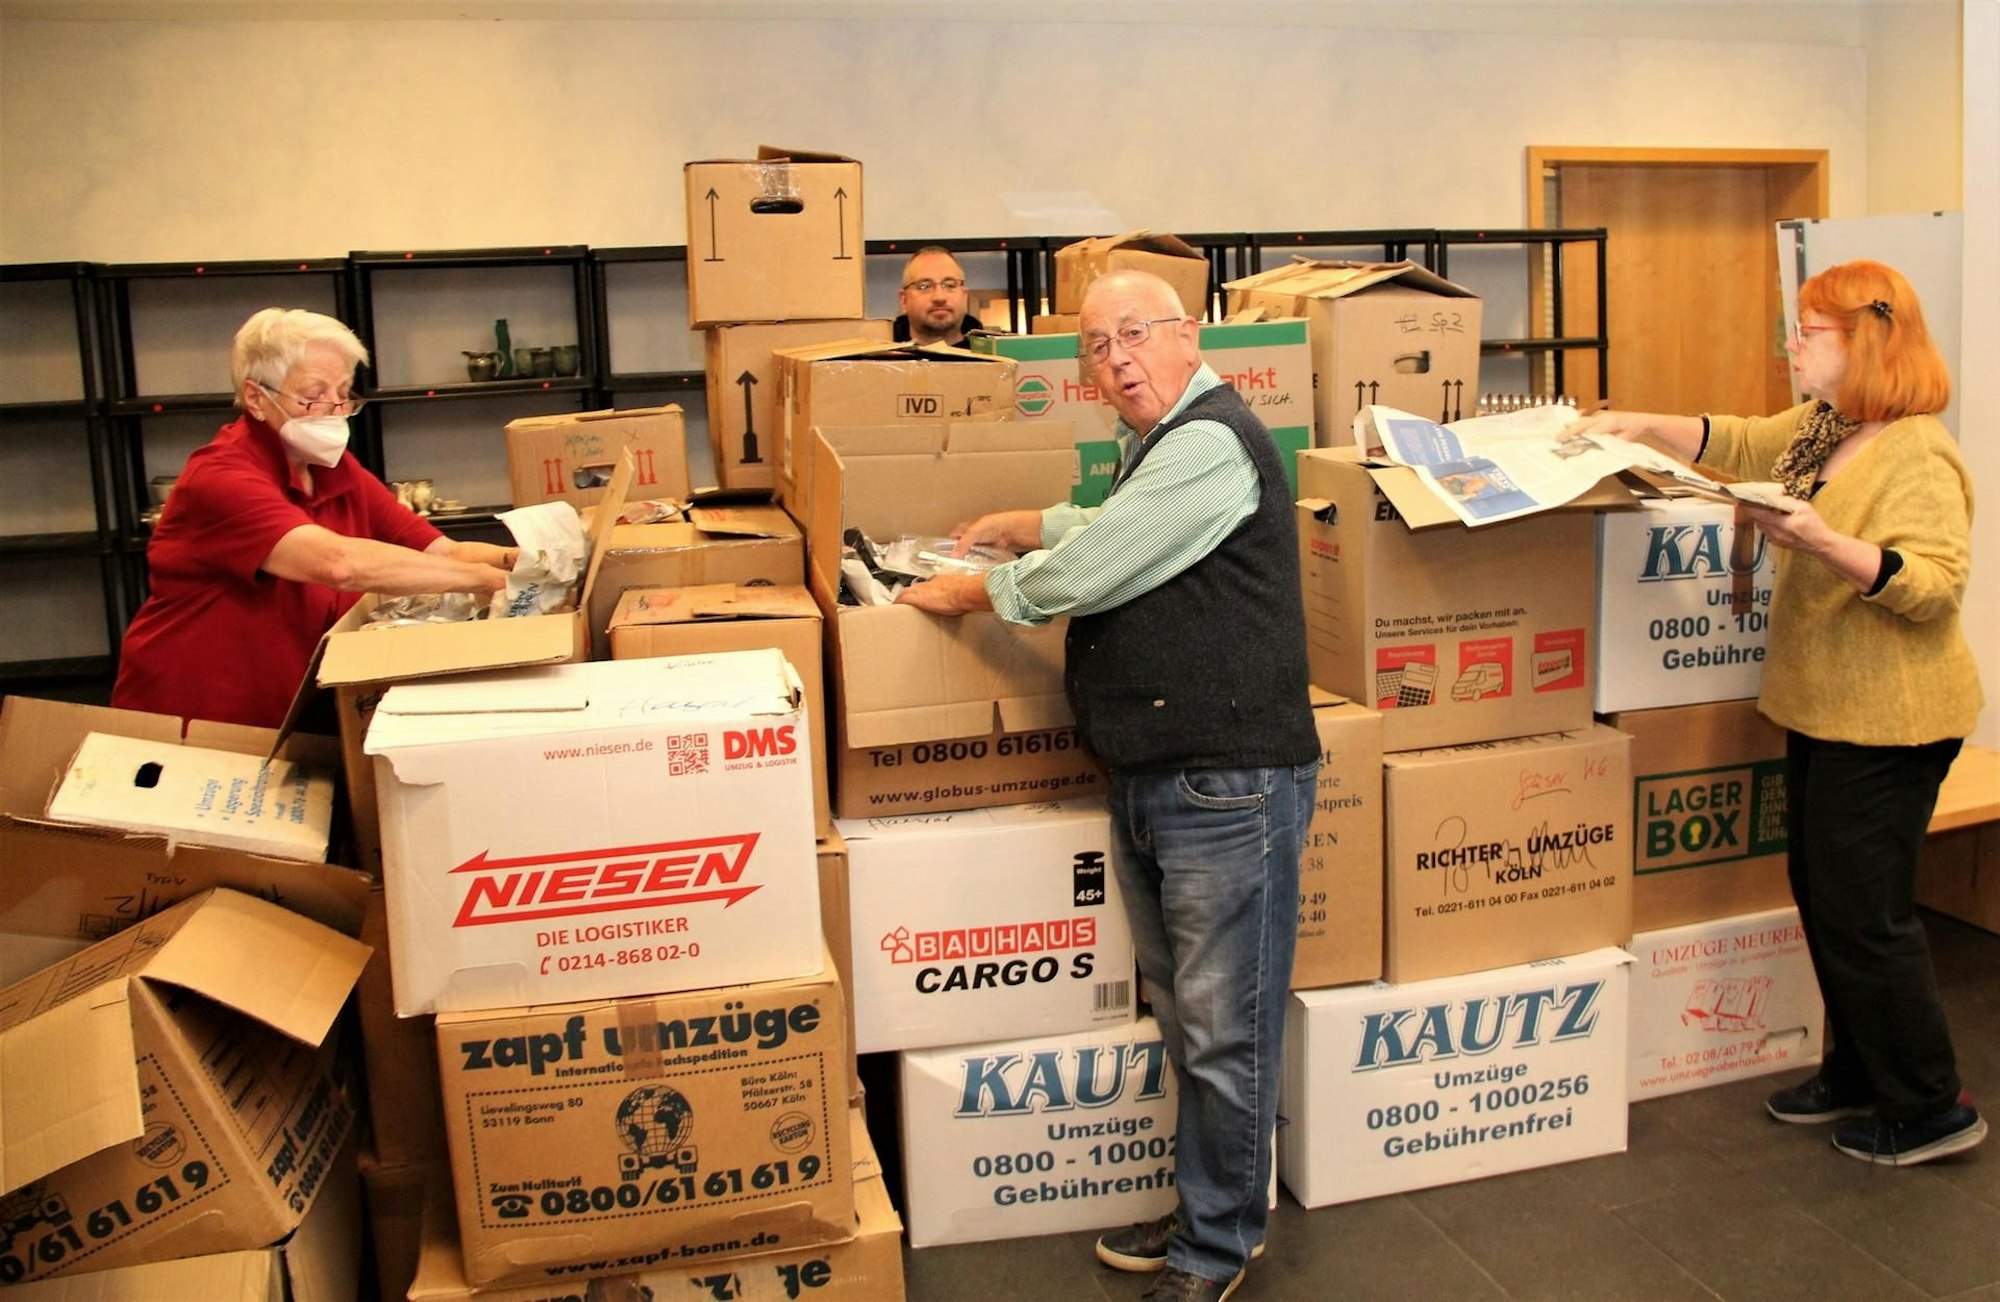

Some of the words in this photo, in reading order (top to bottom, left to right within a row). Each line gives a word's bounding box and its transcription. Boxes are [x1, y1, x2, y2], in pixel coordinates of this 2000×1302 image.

[906, 398, 937, 414] IVD
[1639, 522, 1769, 583] KAU
[1375, 618, 1390, 628] Du
[1392, 614, 1434, 626] machst,
[1437, 612, 1453, 623] wir
[1455, 609, 1492, 622] packen
[1494, 607, 1510, 617] mit
[1512, 606, 1527, 615] an.
[1650, 616, 1710, 641] 0800
[1375, 629, 1406, 639] Unsere
[1407, 626, 1443, 637] Services
[1445, 624, 1458, 633] für
[1459, 622, 1477, 632] dein
[1662, 644, 1766, 670] Gebühre
[543, 738, 653, 761] www.niesen.de
[722, 725, 797, 760] DMS
[869, 749, 902, 768] Tel
[913, 740, 988, 766] 0800
[997, 730, 1079, 755] 616161
[725, 762, 753, 771] UMZUG
[765, 757, 797, 768] LOGISTIK
[869, 772, 1096, 805] www.globus-umzuege.de
[1760, 786, 1787, 801] DEN
[1761, 774, 1784, 789] GIB
[1315, 794, 1363, 813] stpreis
[1647, 780, 1743, 818] LAGER
[1417, 842, 1503, 871] RICHTER
[1527, 824, 1615, 854] UMZÜGE
[1646, 809, 1741, 860] BOX
[1076, 866, 1102, 875] Weight
[1308, 858, 1324, 871] 38
[1495, 863, 1542, 884] KÖLN
[458, 846, 754, 914] NIESEN
[1076, 889, 1103, 901] 45+
[1310, 891, 1327, 905] 49
[1414, 907, 1436, 917] Tel.
[1438, 899, 1486, 914] 0221-611
[1488, 897, 1503, 906] 04
[1504, 894, 1519, 904] 00
[1520, 891, 1539, 903] Fax
[1542, 885, 1587, 899] 0221-611
[1589, 881, 1602, 891] 04
[1603, 876, 1616, 888] 02
[1310, 909, 1326, 923] 40
[536, 930, 569, 948] DIE
[575, 916, 690, 944] LOGISTIKER
[917, 919, 1094, 959] BAUHAUS
[558, 948, 653, 972] 0214-868
[656, 942, 701, 964] 02-0
[1652, 937, 1728, 966] UMZÜGE
[915, 957, 1059, 994] CARGO
[1070, 952, 1094, 979] S
[1352, 978, 1606, 1072] KAUTZ
[461, 1015, 587, 1076] zapf
[603, 1001, 821, 1056] umzüge
[741, 1075, 767, 1087] Büro
[769, 1071, 798, 1083] Köln:
[799, 1079, 813, 1089] 58
[954, 1040, 1166, 1119] KAUT
[1434, 1063, 1528, 1090] Umzüge
[480, 1100, 565, 1116] Lievelingsweg
[568, 1097, 584, 1108] 80
[743, 1099, 778, 1112] 50667
[782, 1094, 807, 1105] Köln
[1366, 1100, 1440, 1130] 0800
[1468, 1074, 1590, 1113] 1000256
[482, 1117, 522, 1129] 53119
[524, 1115, 555, 1126] Bonn
[772, 1120, 811, 1140] RECYCLING
[1047, 1116, 1154, 1141] Umzüge
[1383, 1107, 1573, 1158] Gebührenfrei
[778, 1129, 809, 1145] KARTON
[973, 1151, 1055, 1178] 0800
[489, 1182, 520, 1194] Zum
[522, 1176, 582, 1192] Nulltarif
[540, 1176, 696, 1217] 0800/61
[703, 1169, 744, 1197] 61
[751, 1161, 790, 1189] 61
[798, 1154, 821, 1181] 9
[993, 1167, 1176, 1206] Gebührenfr
[86, 1200, 132, 1239] 61
[136, 1175, 181, 1214] 61
[182, 1160, 209, 1191] 9
[545, 1232, 780, 1277] www.zapf-bonn.de
